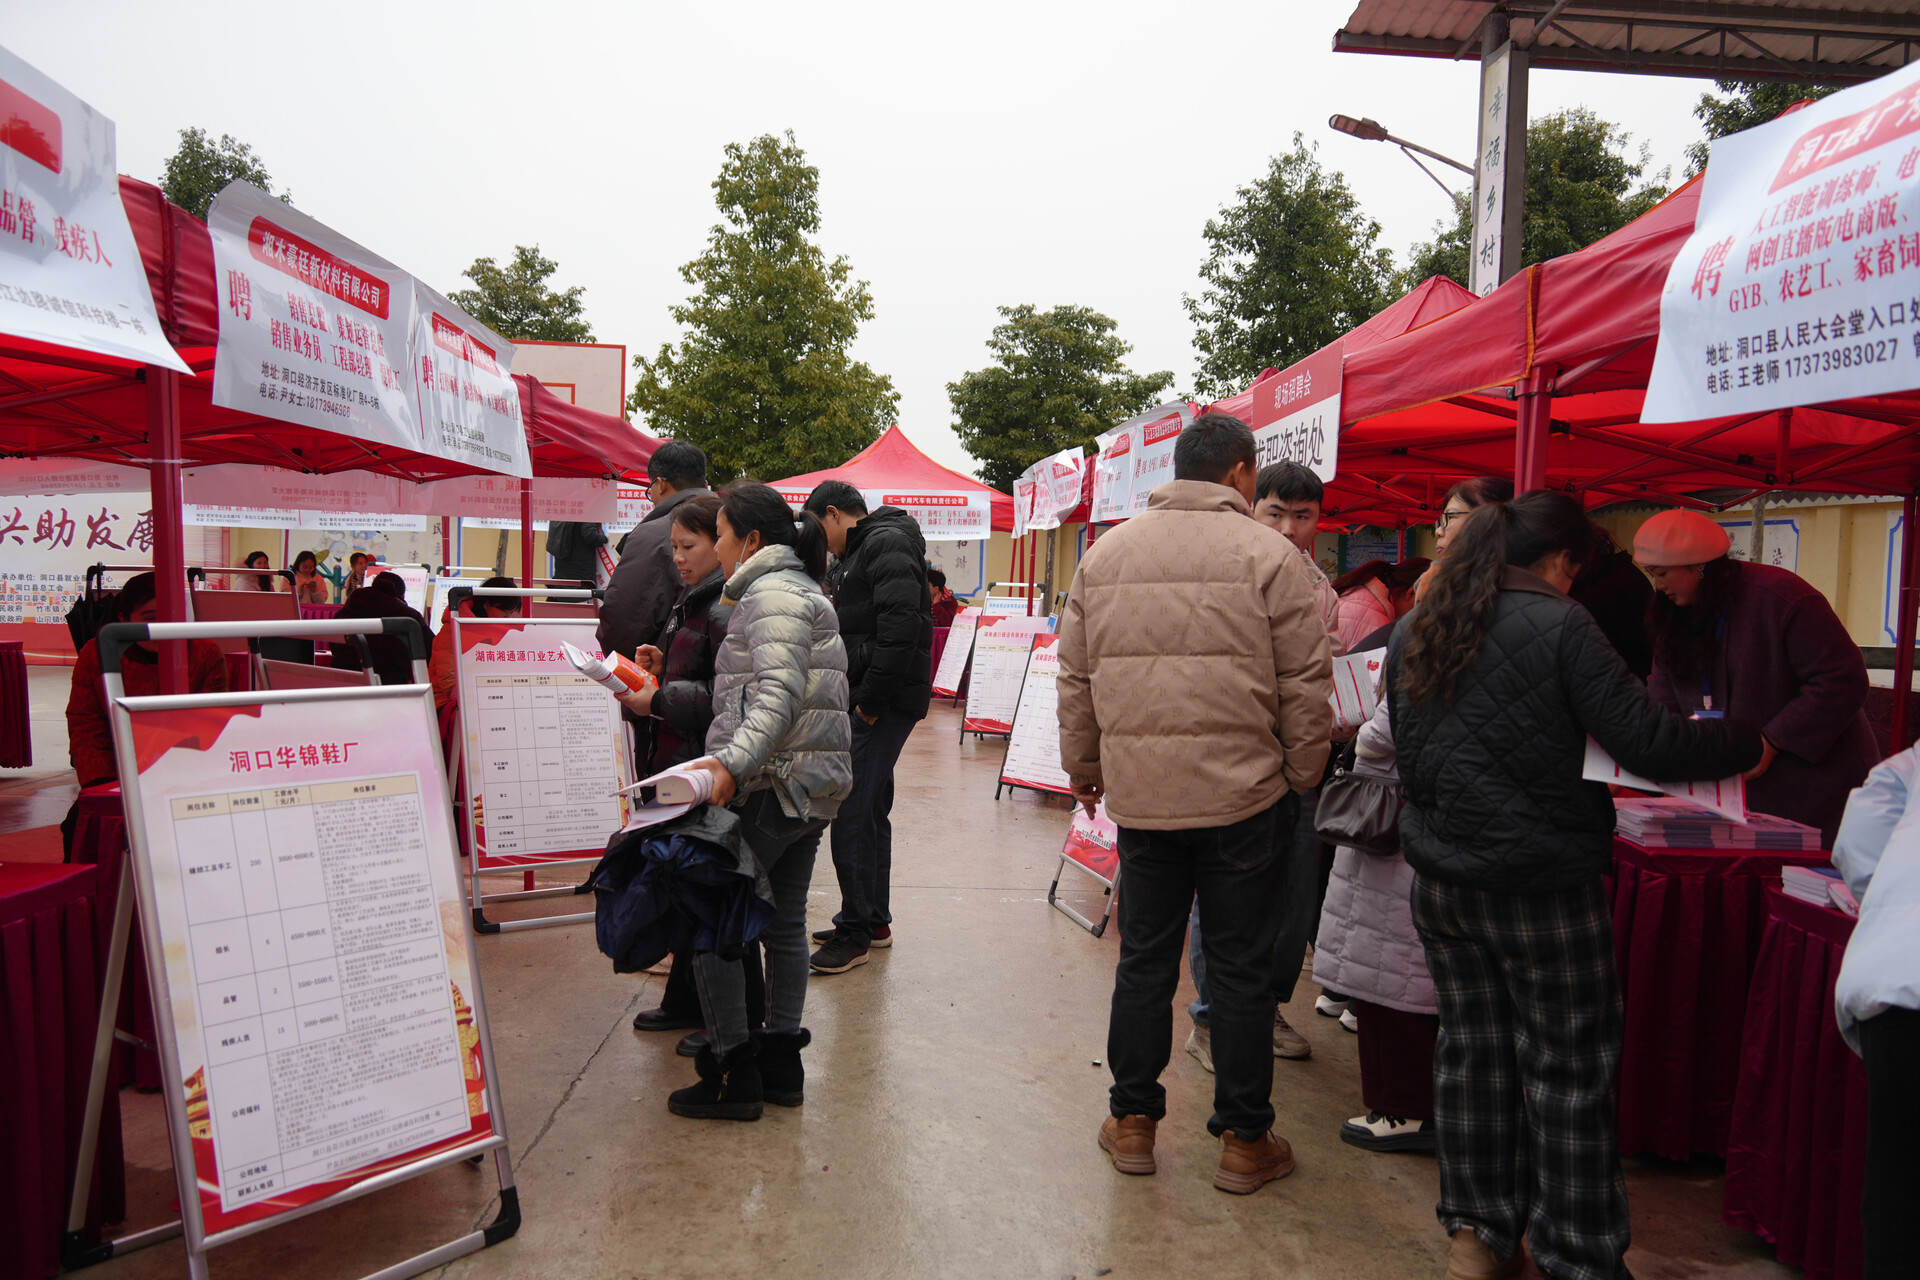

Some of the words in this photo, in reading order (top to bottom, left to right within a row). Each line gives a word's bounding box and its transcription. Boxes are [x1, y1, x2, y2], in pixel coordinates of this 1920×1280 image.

[1692, 234, 1735, 300] 聘
[227, 268, 252, 321] 聘
[1784, 338, 1899, 379] 17373983027
[421, 354, 435, 392] 聘
[1274, 369, 1312, 409] 现场招聘会
[1256, 414, 1324, 473] 求职咨询处
[887, 496, 964, 505] 三一专用汽车有限责任公司
[475, 650, 604, 662] 湖南湘通源门业艺术公司
[229, 741, 360, 774] 洞口华锦鞋厂
[186, 800, 217, 812] 岗位名称
[232, 796, 260, 807] 岗位数量
[273, 787, 300, 798] 工资水平
[215, 944, 231, 956] 组长
[222, 994, 238, 1005] 品管
[221, 1033, 251, 1047] 残疾人员
[231, 1104, 261, 1119] 公司福利
[239, 1163, 268, 1179] 公司地址
[237, 1179, 274, 1197] 联系人电话
